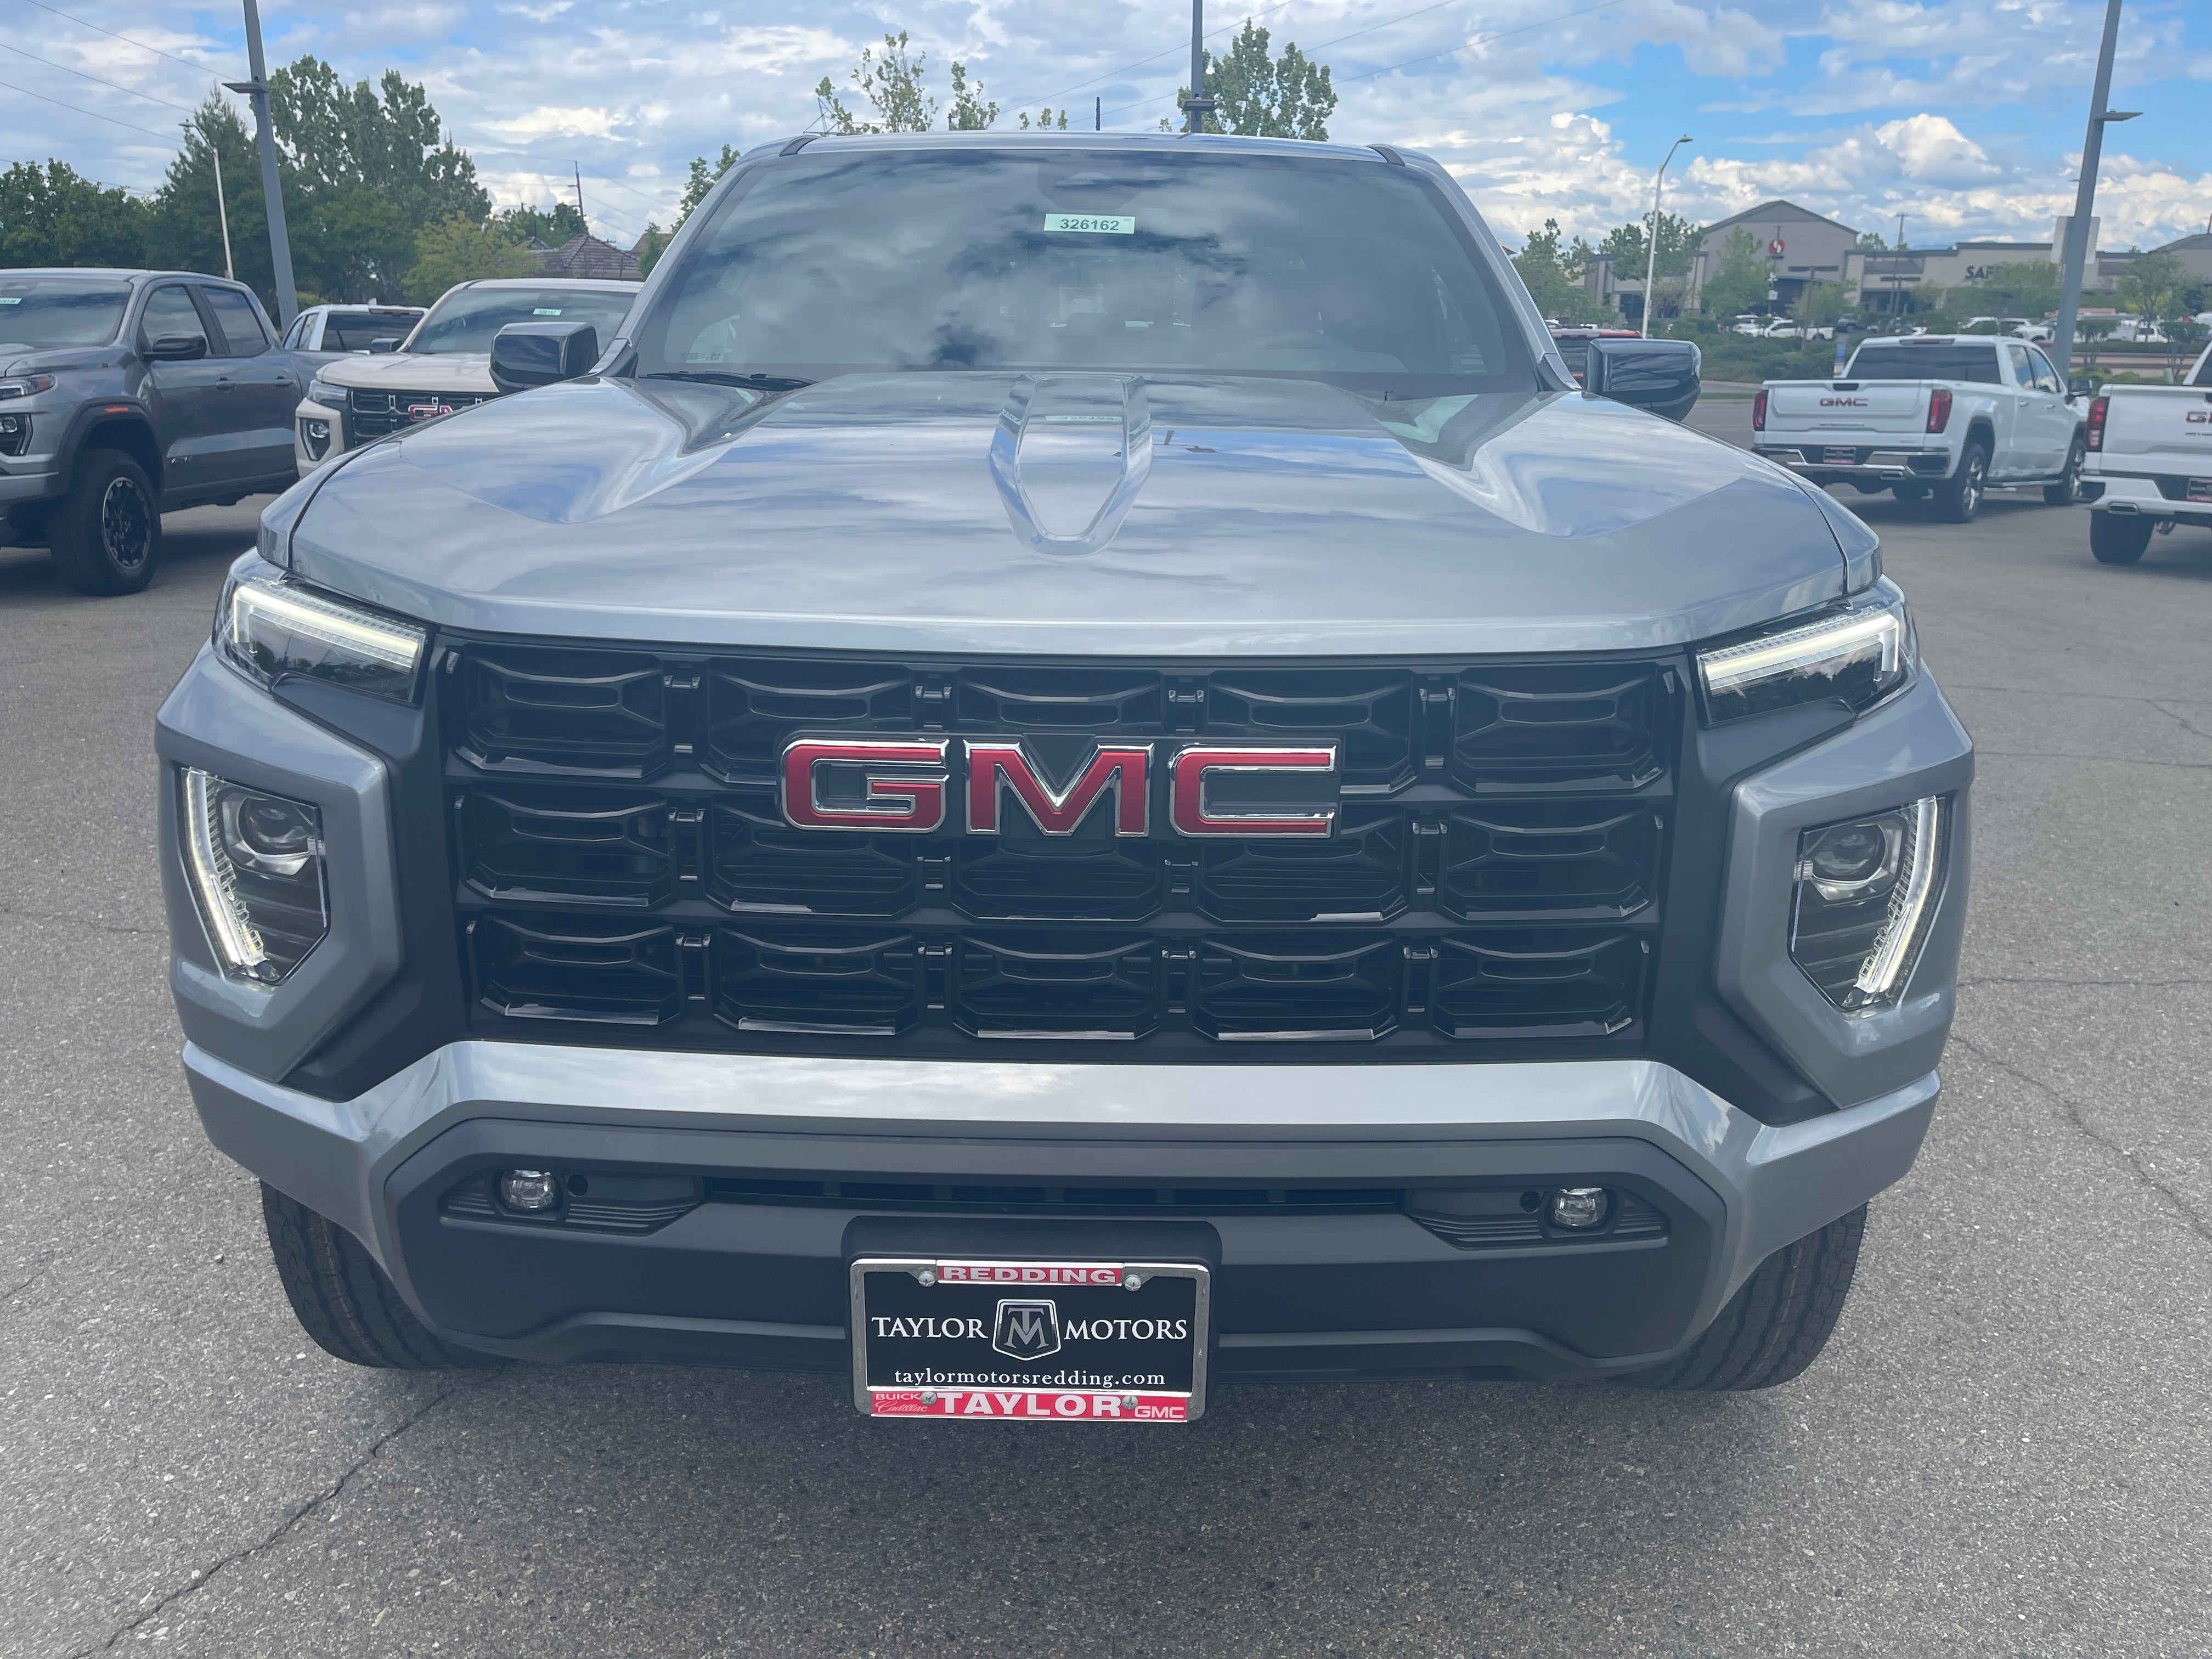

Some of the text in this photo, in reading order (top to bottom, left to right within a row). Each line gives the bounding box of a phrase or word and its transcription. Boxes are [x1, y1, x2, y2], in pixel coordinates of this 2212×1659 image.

[1060, 218, 1119, 231] 326162
[1820, 397, 1868, 407] GMC
[781, 738, 1336, 838] GMC
[944, 1266, 1116, 1283] REDDING
[871, 1317, 989, 1339] TAYLOR
[1064, 1319, 1187, 1340] MOTORS
[895, 1368, 1165, 1388] taylormotorsredding.com
[875, 1401, 928, 1413] Cadillac
[937, 1392, 1121, 1417] TAYLOR
[1135, 1406, 1184, 1419] GMC
